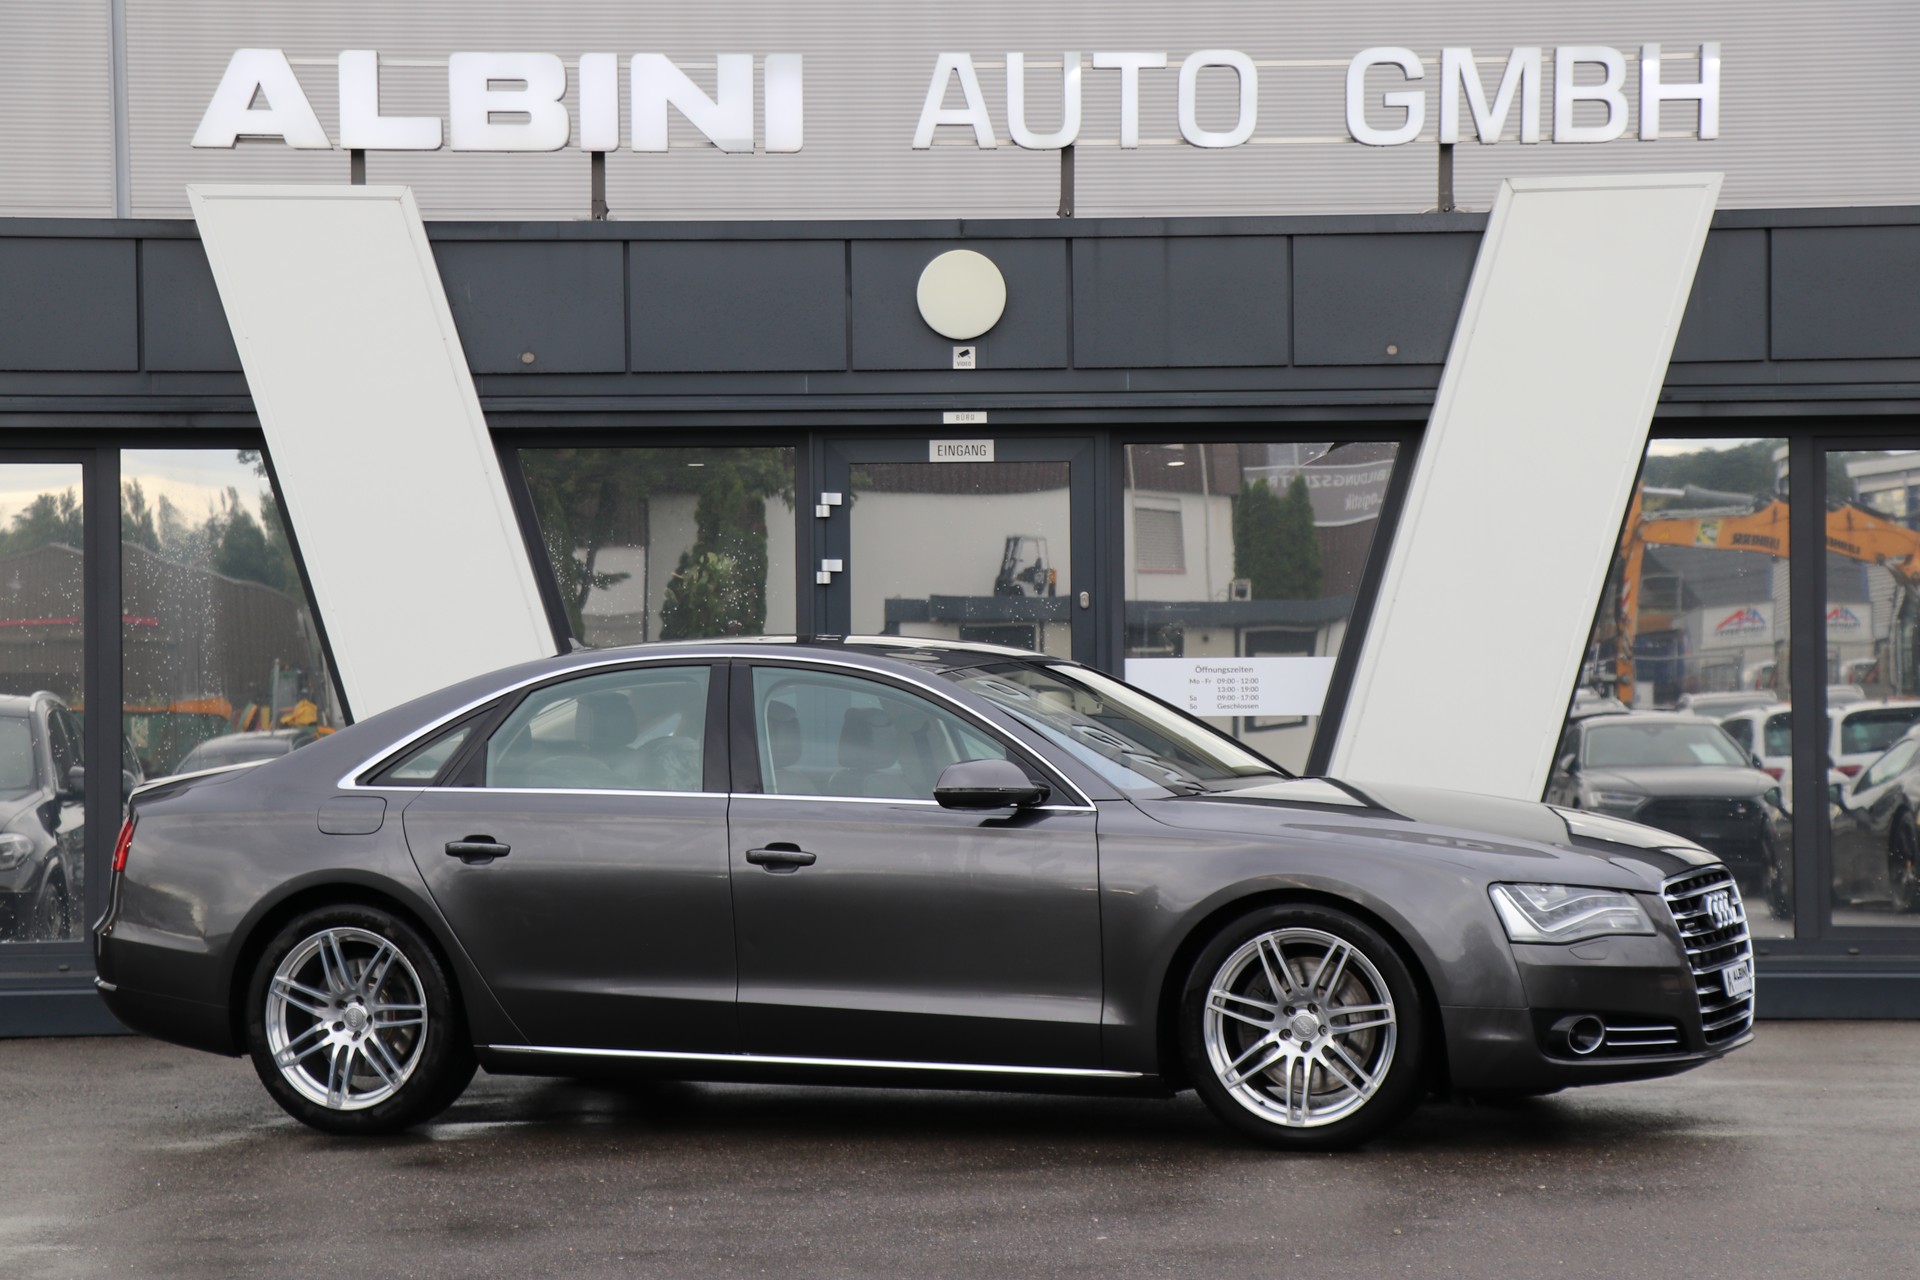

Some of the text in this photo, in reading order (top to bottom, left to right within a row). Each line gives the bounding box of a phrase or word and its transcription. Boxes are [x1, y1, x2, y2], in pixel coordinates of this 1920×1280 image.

[191, 42, 1721, 153] ALBINI AUTO GMBH
[937, 444, 987, 457] EINGANG
[1195, 665, 1254, 674] Öffnungszeiten
